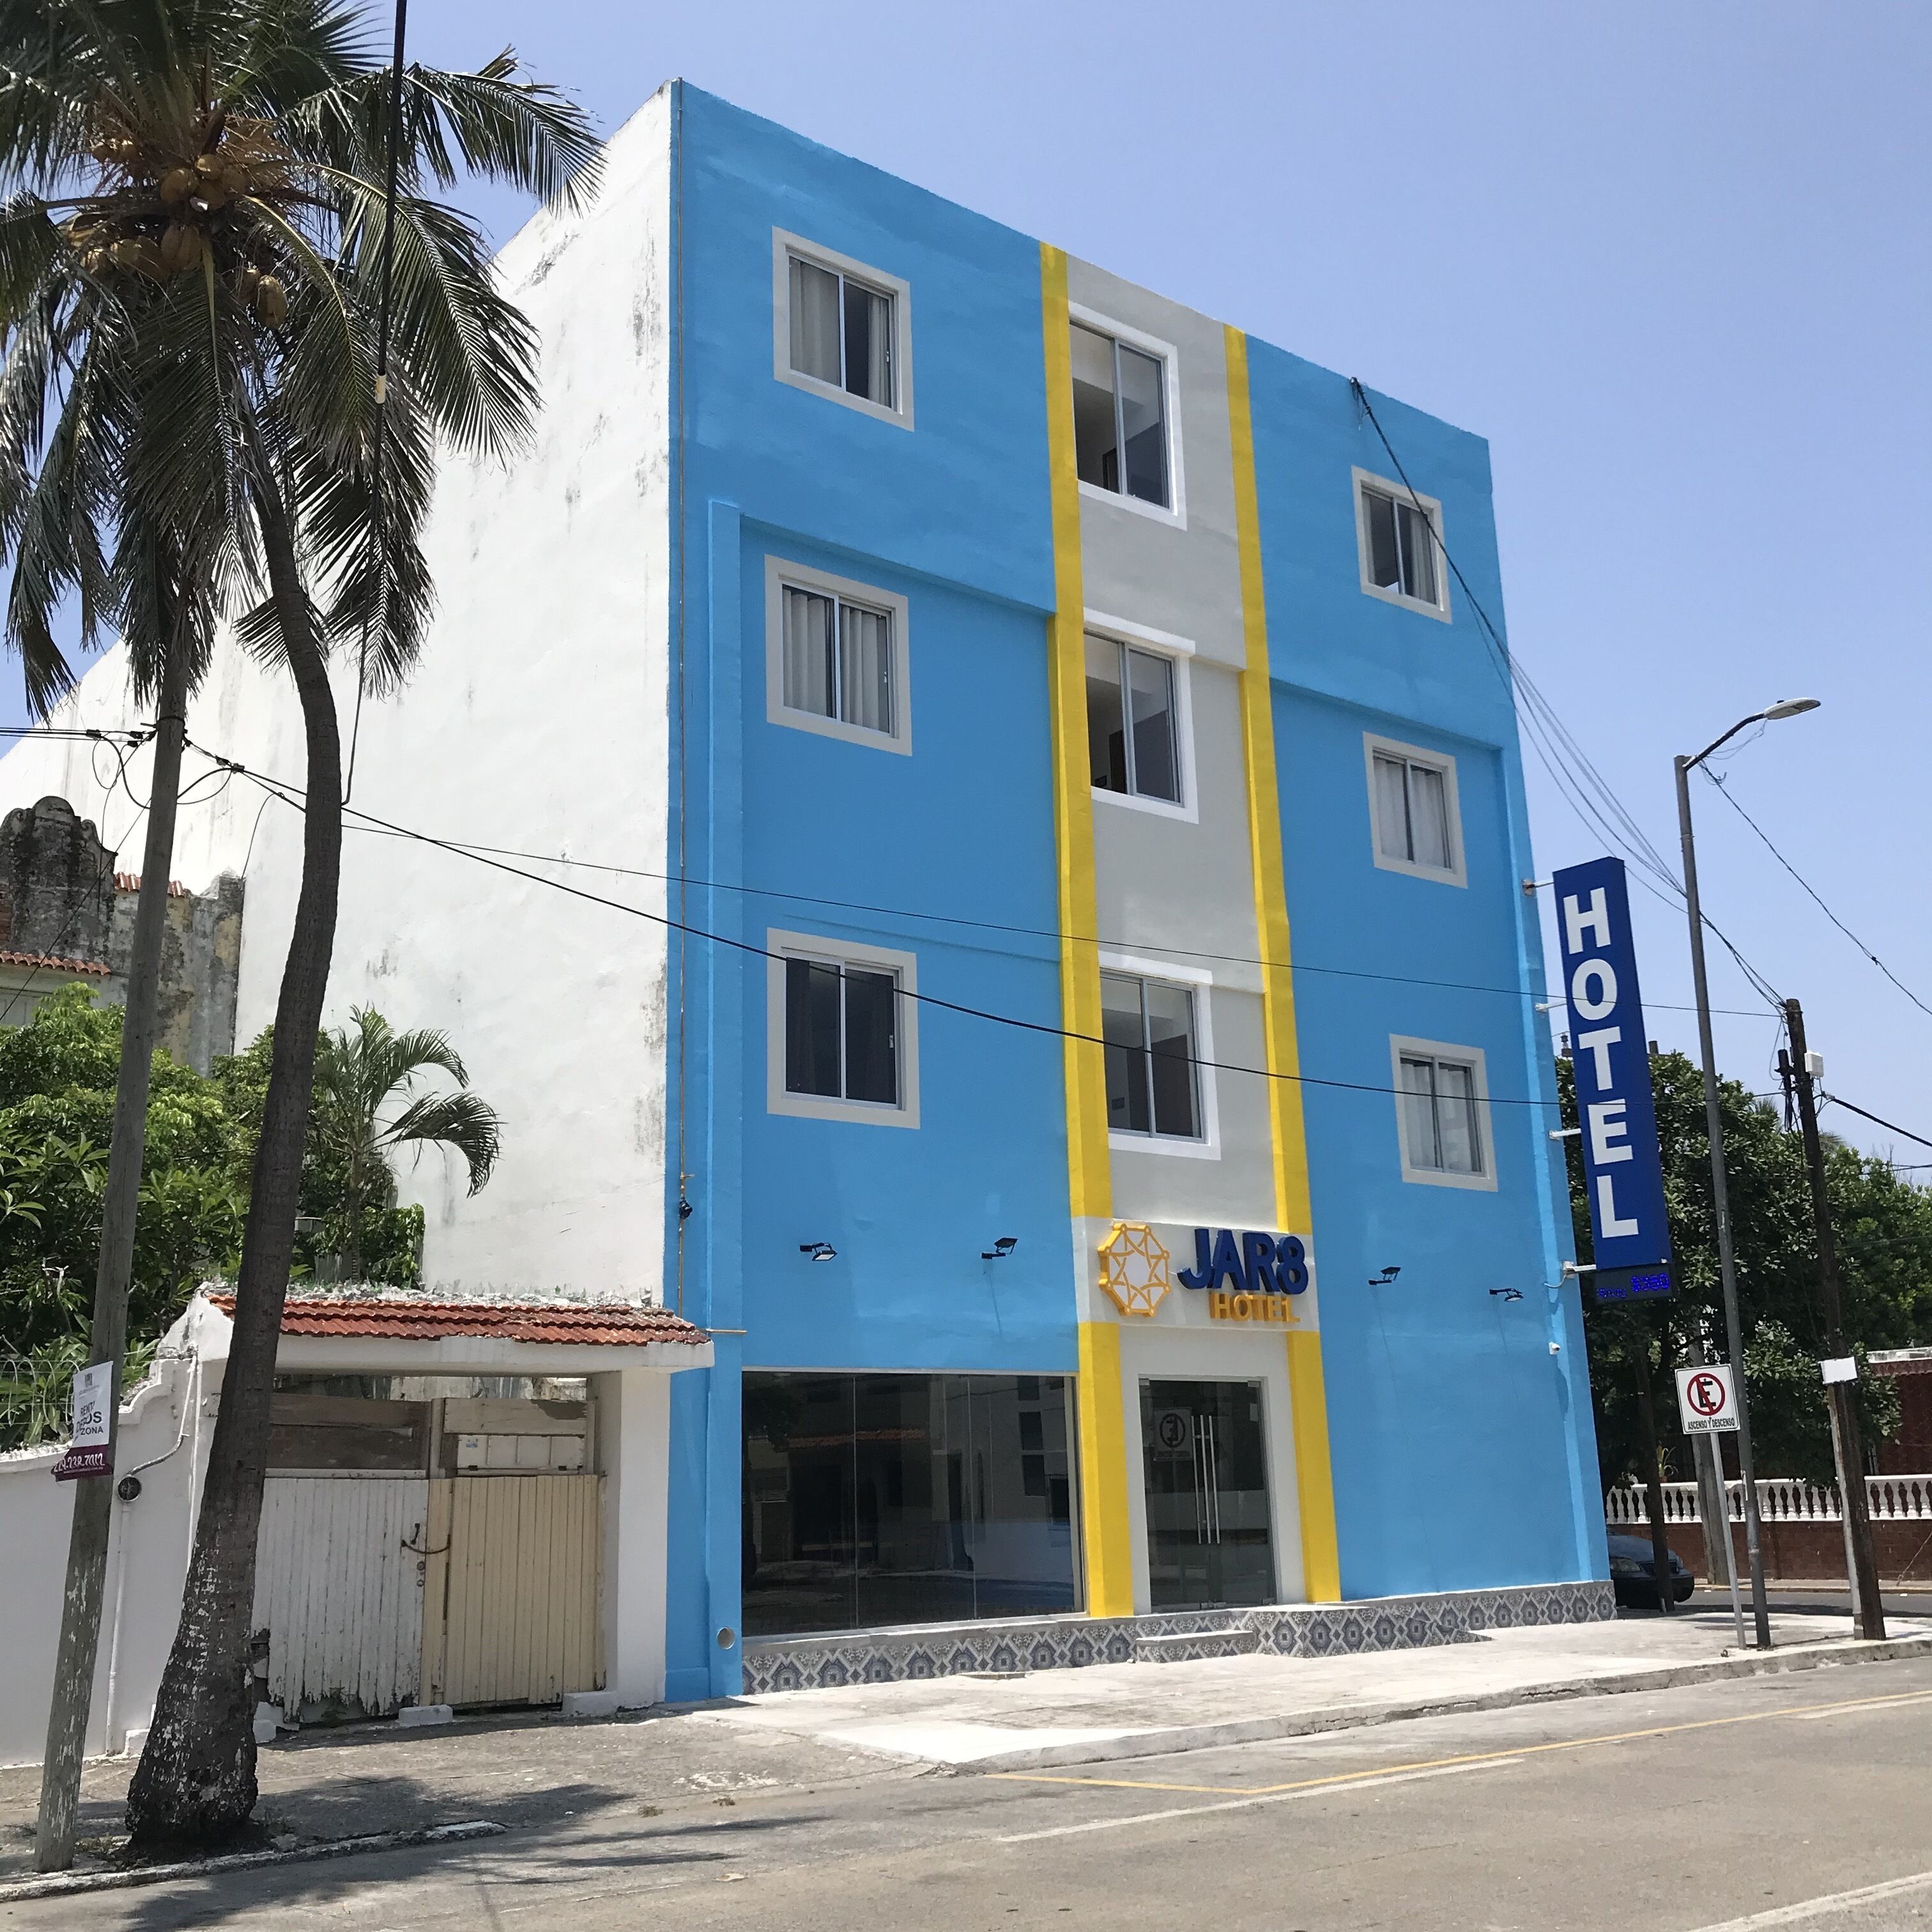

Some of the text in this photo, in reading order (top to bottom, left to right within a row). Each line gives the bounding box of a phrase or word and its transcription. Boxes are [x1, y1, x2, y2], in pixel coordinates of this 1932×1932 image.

[1563, 887, 1639, 1238] HOTEL
[1177, 1228, 1309, 1295] JAR8
[1209, 1292, 1301, 1323] HOTEL
[1696, 1380, 1717, 1408] E
[80, 1425, 104, 1436] ZONA
[1688, 1420, 1707, 1430] ASCENSO
[1712, 1417, 1735, 1428] DESCENSO
